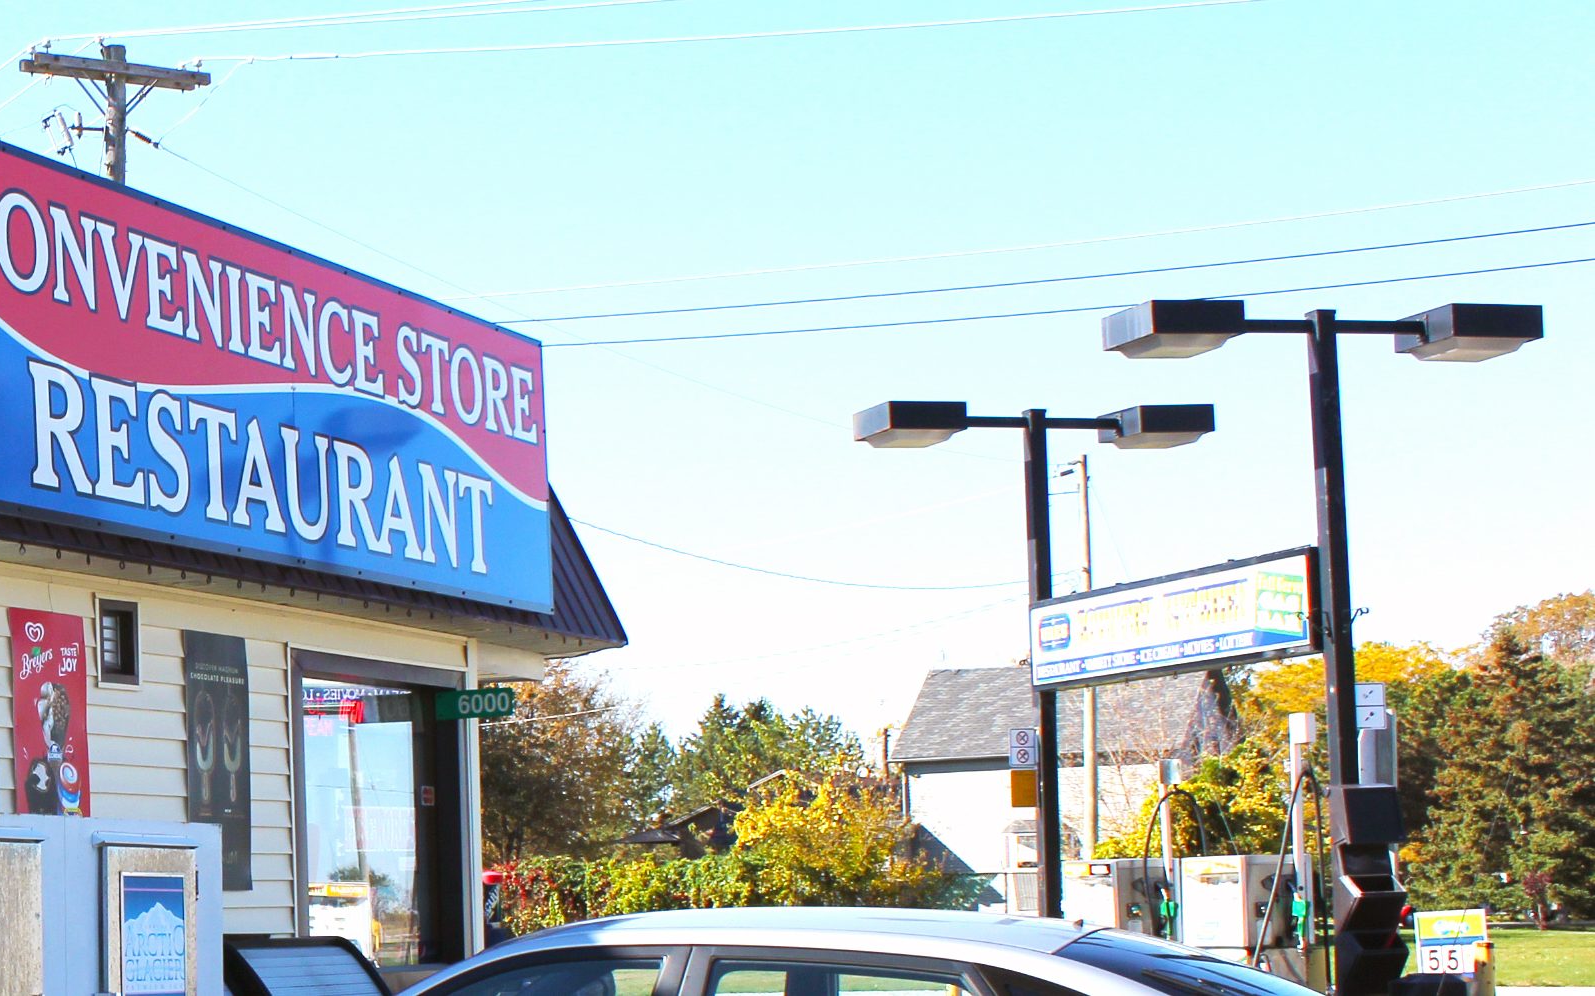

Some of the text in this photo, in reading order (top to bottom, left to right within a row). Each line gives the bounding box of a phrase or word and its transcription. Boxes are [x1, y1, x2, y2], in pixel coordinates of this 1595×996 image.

[394, 321, 540, 446] STORE
[28, 358, 494, 576] RESTAURANT
[20, 648, 53, 680] Breyers
[60, 647, 77, 656] TASTE
[61, 658, 77, 672] JOY
[458, 691, 510, 715] 6000
[125, 925, 184, 957] ARCTIC
